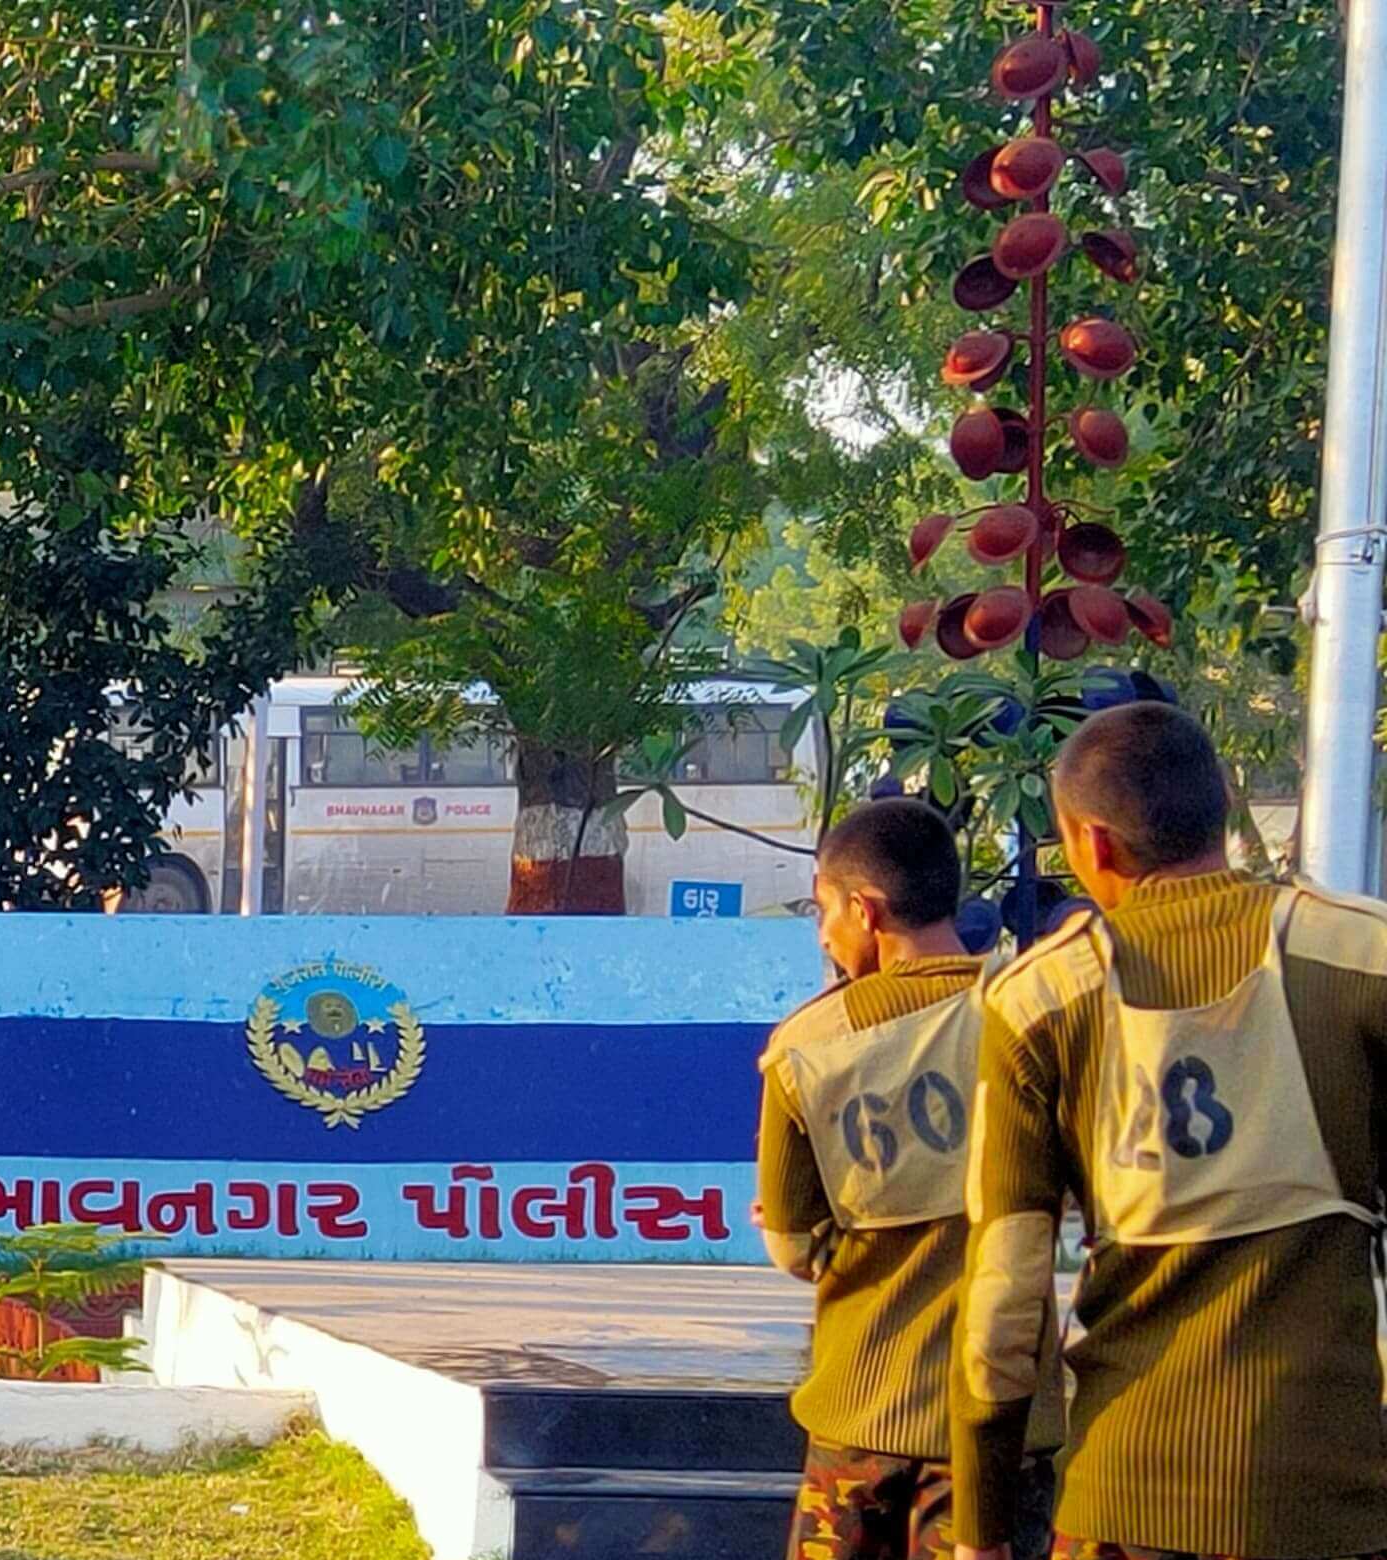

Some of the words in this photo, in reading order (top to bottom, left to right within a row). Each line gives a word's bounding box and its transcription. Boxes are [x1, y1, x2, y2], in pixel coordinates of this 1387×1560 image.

[326, 804, 406, 817] BHAVNAGAR
[445, 804, 492, 816] POLICE
[842, 1070, 967, 1172] 60
[402, 1163, 730, 1240] પોલીસ
